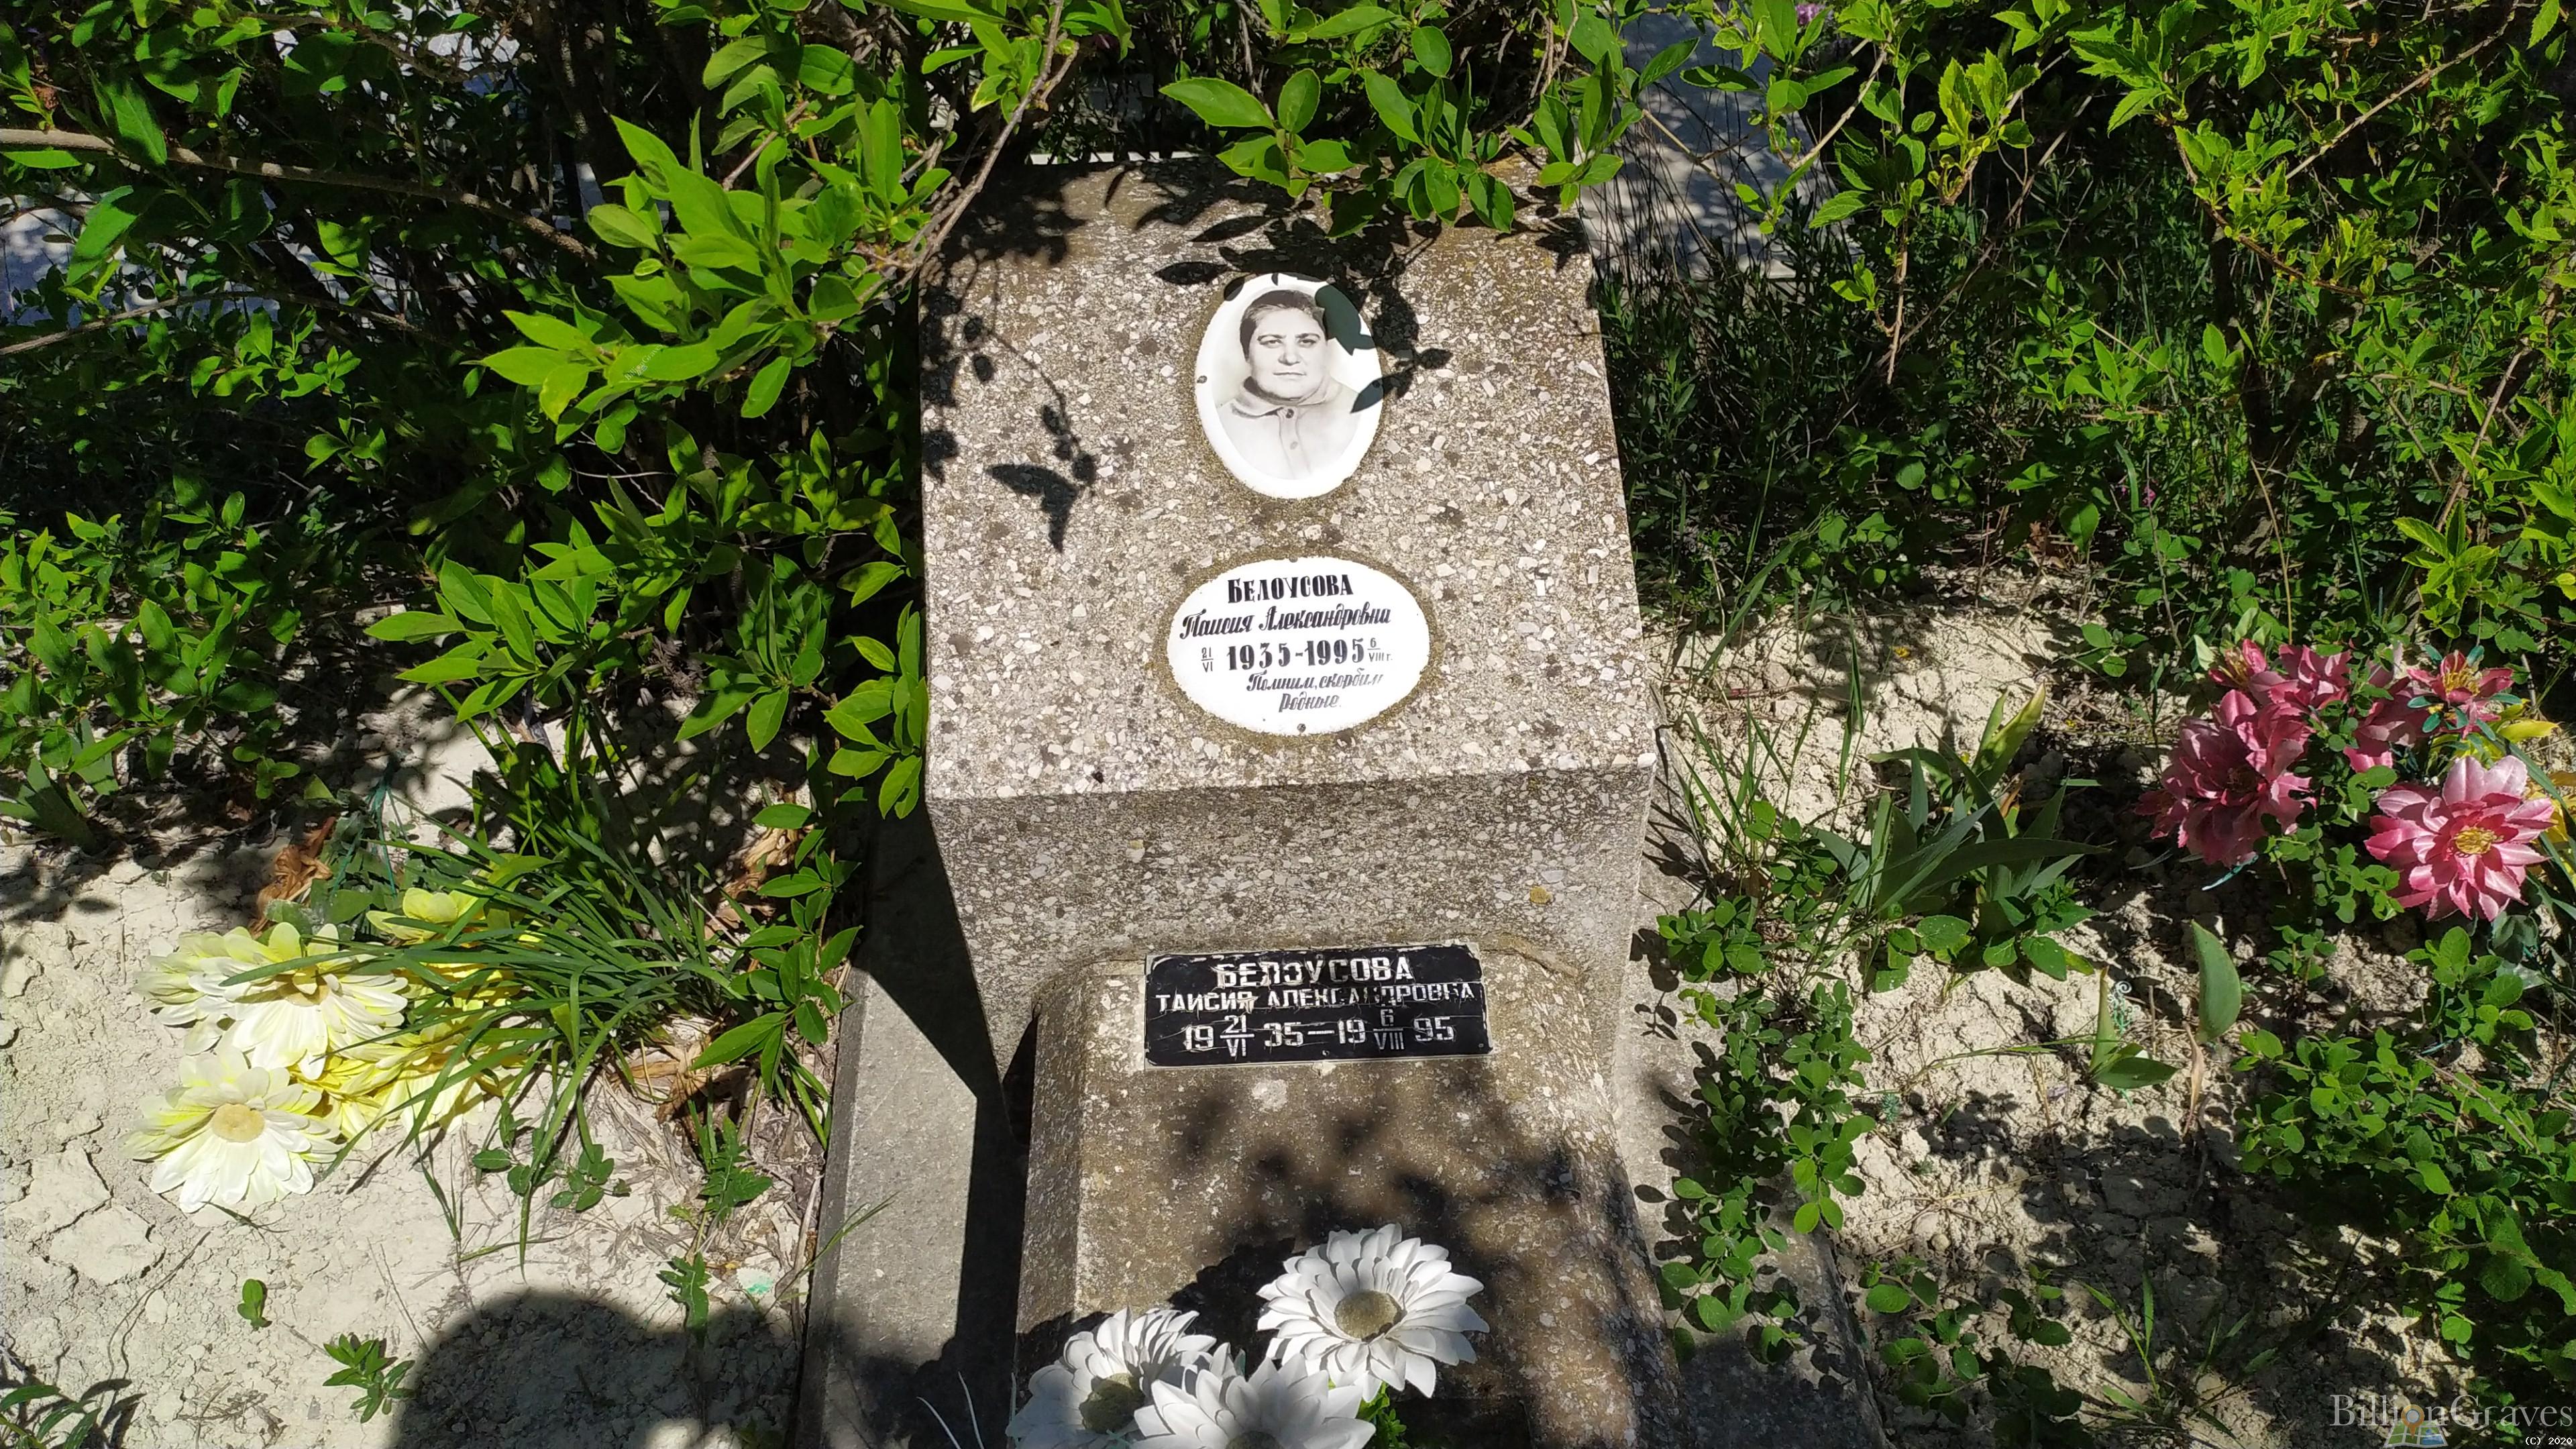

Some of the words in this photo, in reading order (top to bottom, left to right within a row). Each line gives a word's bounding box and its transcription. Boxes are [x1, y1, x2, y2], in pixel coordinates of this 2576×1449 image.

[1227, 574, 1354, 603] БЕЛОУСОВА
[1179, 608, 1255, 639] Таисия
[1258, 601, 1391, 631] Александровна
[1216, 956, 1413, 988] БЕЛОУСОВА
[1156, 991, 1255, 1012] ТАИСИЯ
[1224, 1014, 1247, 1033] 21
[1380, 1009, 1395, 1026] 6
[1413, 1016, 1454, 1042] 95
[1185, 1025, 1214, 1051] 19
[1226, 1038, 1247, 1057] VI
[1373, 1032, 1405, 1050] VIII
